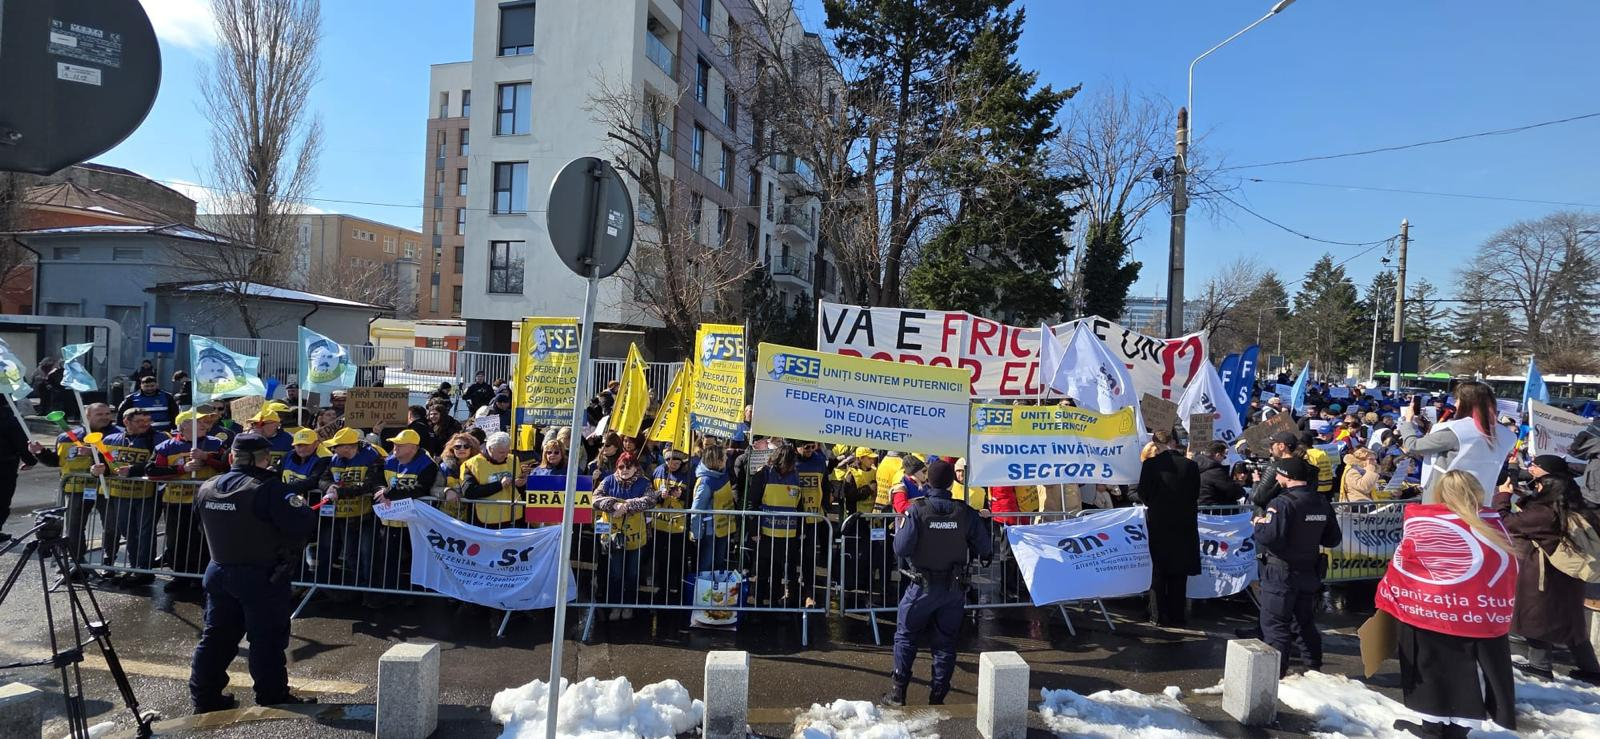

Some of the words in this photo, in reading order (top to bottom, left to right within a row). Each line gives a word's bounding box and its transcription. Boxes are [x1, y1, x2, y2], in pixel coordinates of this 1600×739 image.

[545, 328, 577, 350] FSE
[822, 304, 875, 347] VĂ
[896, 310, 926, 350] E
[941, 313, 1056, 359] FRIC
[1121, 329, 1165, 364] UN
[713, 335, 744, 358] FSE
[785, 356, 820, 376] FSE
[524, 374, 578, 385] SINDICATELO
[823, 367, 851, 383] UNIȚI
[854, 372, 900, 386] SUNTEM
[902, 378, 963, 393] PUTERNICI!
[526, 385, 543, 394] DIN
[556, 396, 576, 405] HAR
[786, 388, 855, 409] FEDERAȚIA
[857, 399, 946, 418] SINDICATELOR
[350, 410, 365, 419] STĂ
[371, 410, 380, 419] ÎN
[383, 411, 396, 420] LOC
[554, 409, 574, 417] SUNT
[824, 408, 845, 420] DIN
[849, 411, 909, 429] EDUCAȚIE
[986, 409, 1012, 424] FSE
[1054, 410, 1098, 425] SUNTEM
[1032, 421, 1087, 432] PUTERNICI!
[981, 443, 1047, 455] SINDICAT
[1008, 463, 1096, 481] SECTOR
[1101, 463, 1113, 479] 5
[929, 520, 958, 529] JANDARMERIA
[1353, 528, 1404, 547] GIURG
[1462, 611, 1482, 623] de
